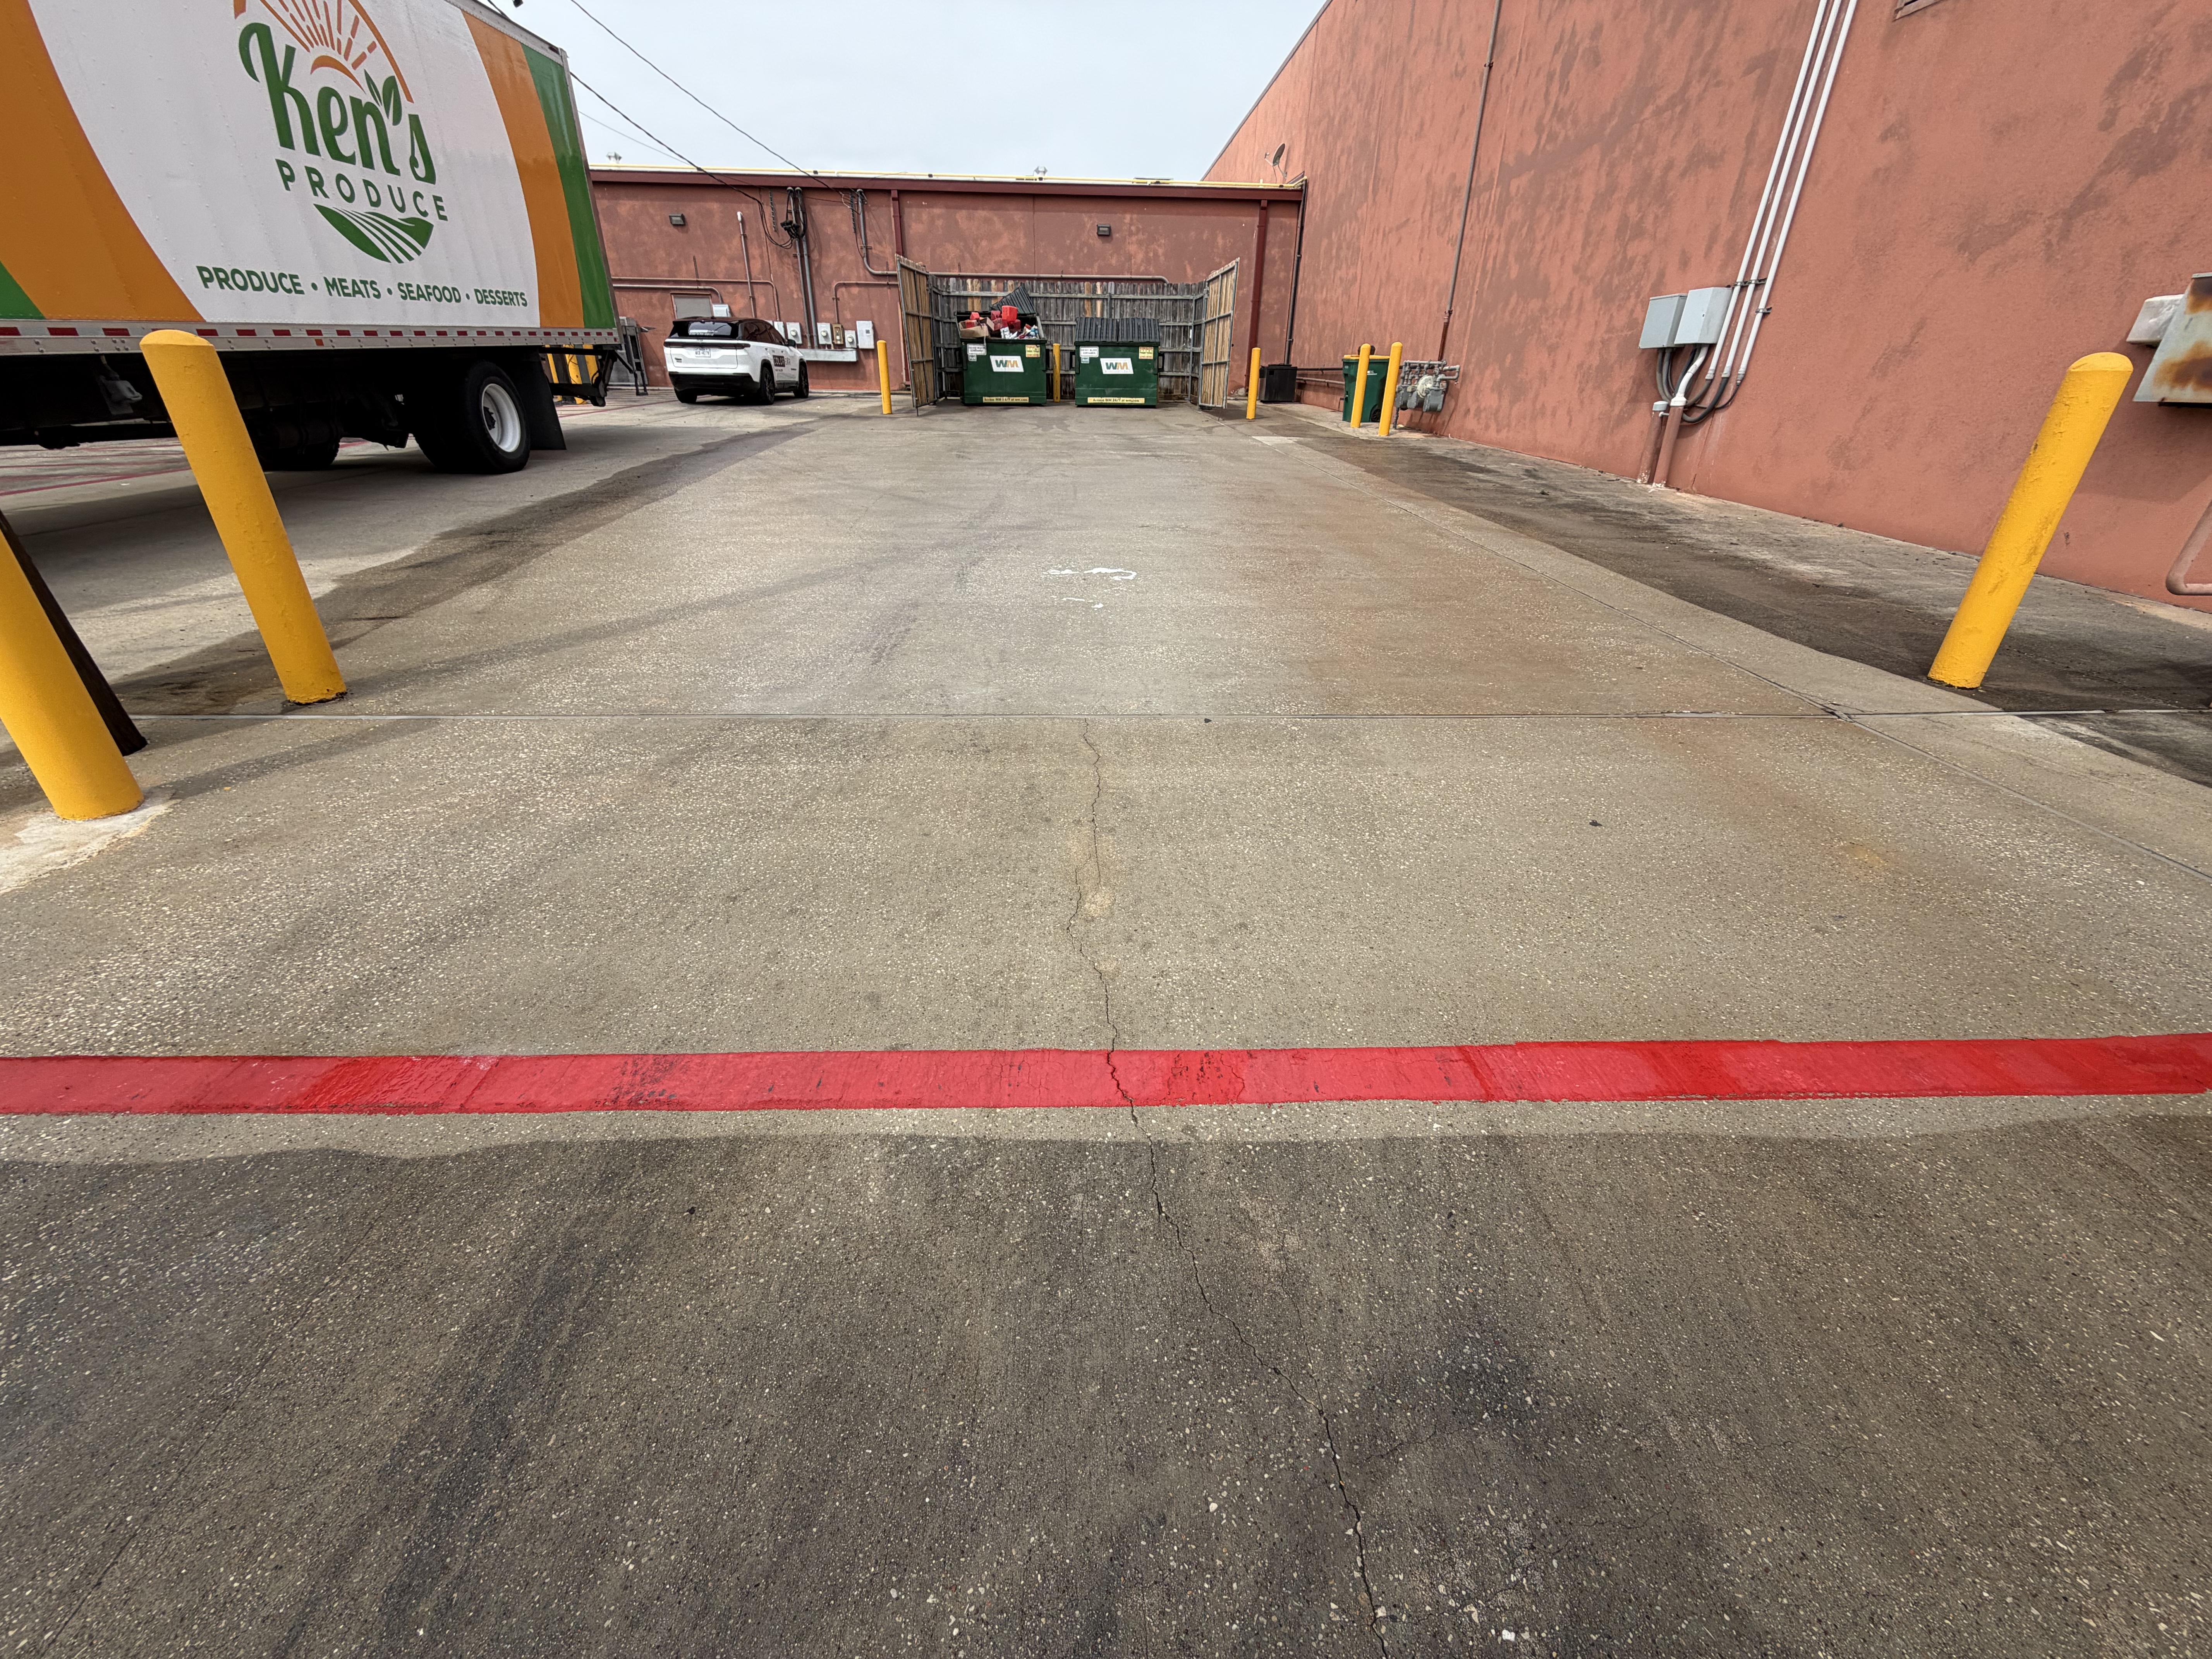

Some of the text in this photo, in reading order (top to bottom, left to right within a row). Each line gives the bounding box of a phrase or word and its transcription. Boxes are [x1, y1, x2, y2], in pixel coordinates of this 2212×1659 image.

[239, 22, 436, 185] Ken's
[275, 159, 448, 221] PRODUCE
[196, 265, 528, 307] PRODUCE MEATS SEAFOOD DESSERTS
[995, 360, 1019, 368] WM
